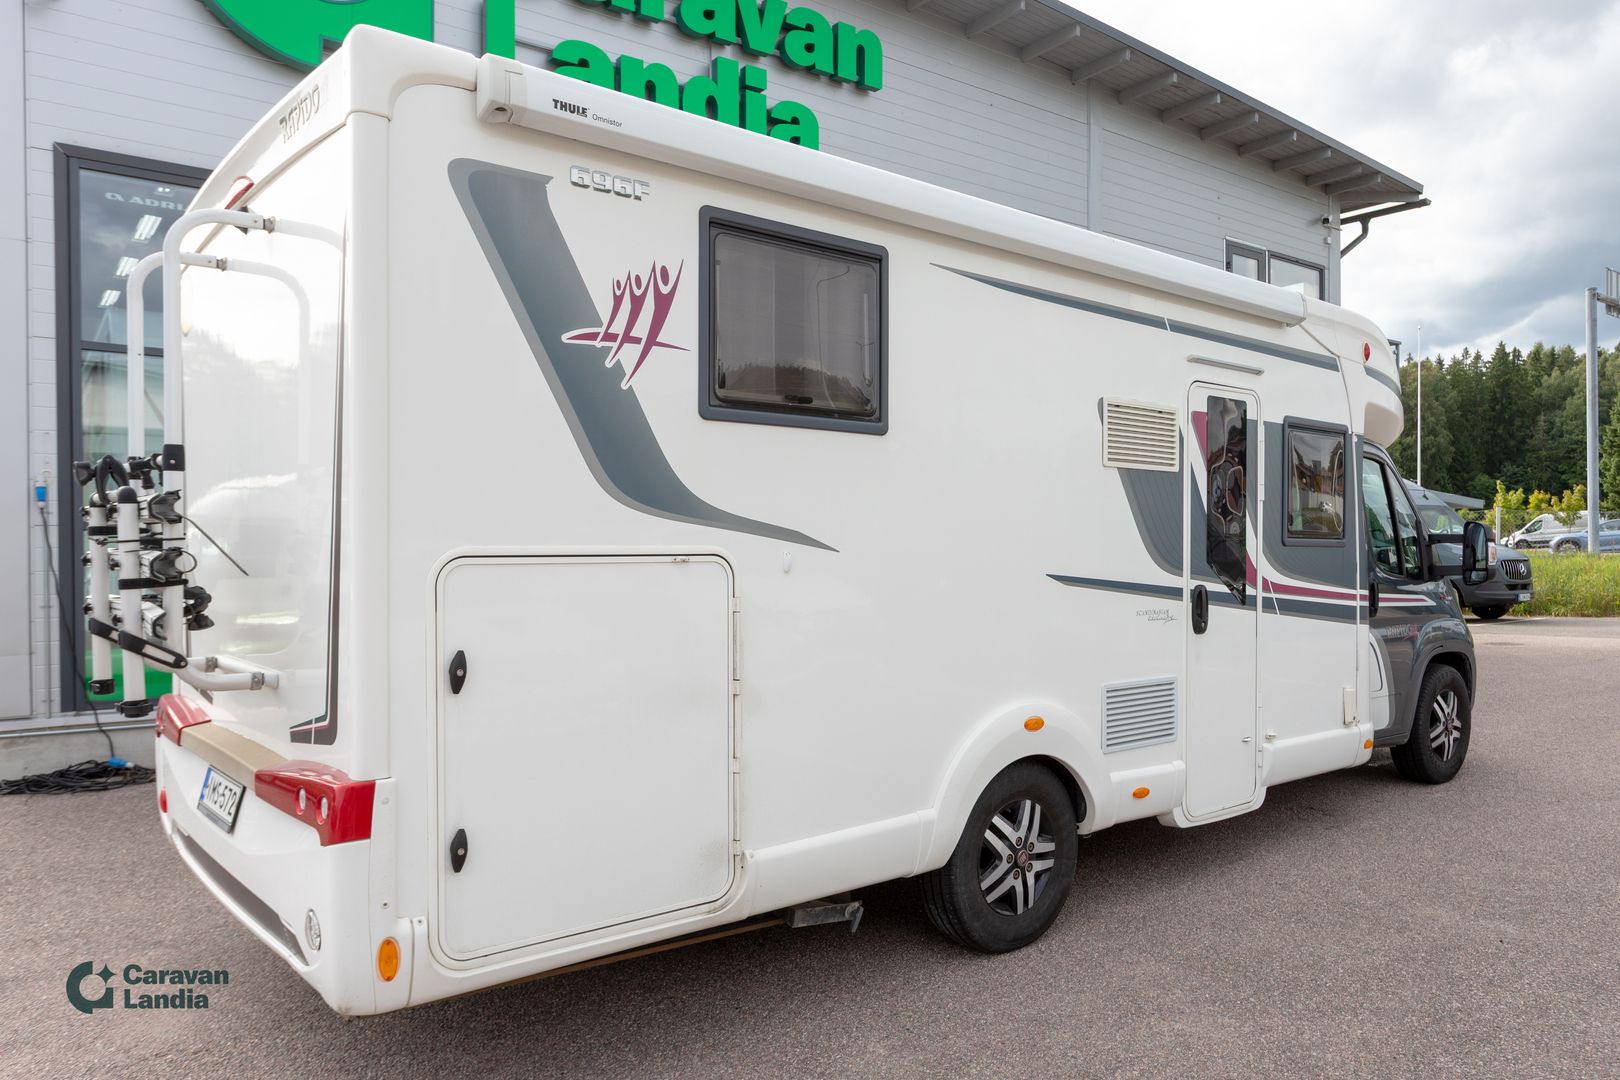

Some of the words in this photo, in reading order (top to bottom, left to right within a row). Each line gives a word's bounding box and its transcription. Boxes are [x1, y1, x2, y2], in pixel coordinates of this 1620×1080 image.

[576, 0, 883, 91] avan
[279, 84, 321, 144] RAPIDO
[552, 98, 589, 118] THULE
[592, 113, 623, 128] Omnistor
[570, 165, 651, 201] 696F
[128, 196, 186, 211] ADRI
